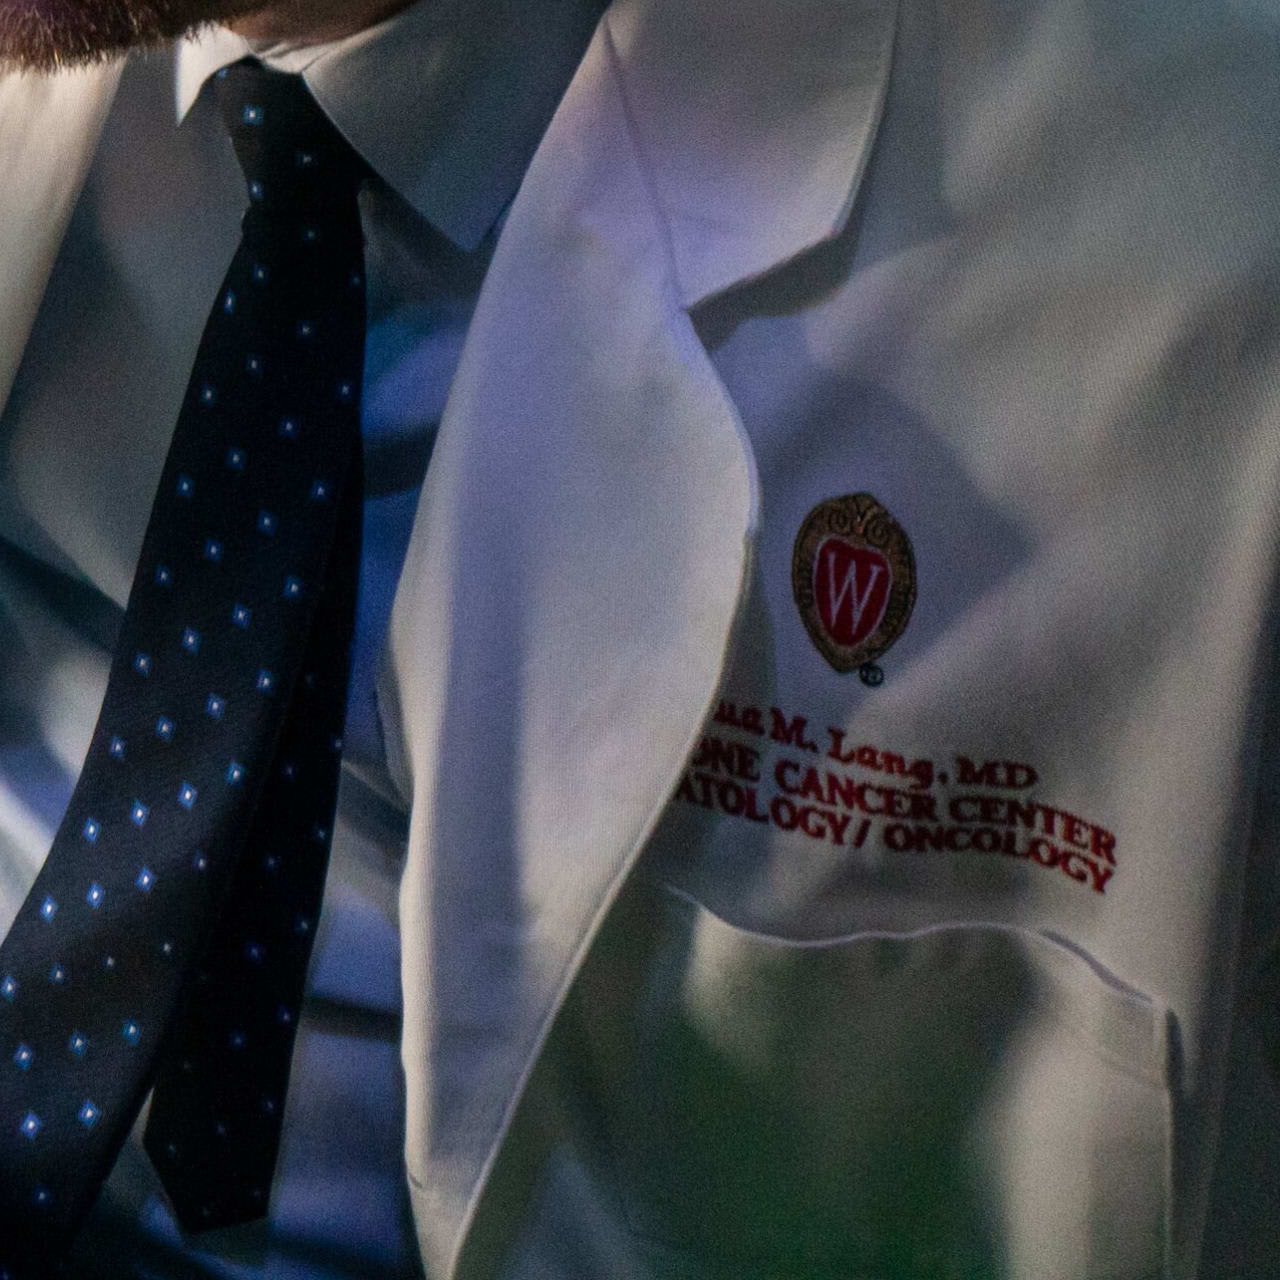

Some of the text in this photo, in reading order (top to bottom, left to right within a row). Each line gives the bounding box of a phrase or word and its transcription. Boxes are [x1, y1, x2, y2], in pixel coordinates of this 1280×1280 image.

[826, 549, 884, 635] W
[770, 706, 818, 753] M.
[956, 755, 1038, 789] MD
[775, 759, 938, 822] CANCER
[949, 795, 1117, 866] CENTER
[883, 824, 1114, 894] ONCOLOGY
